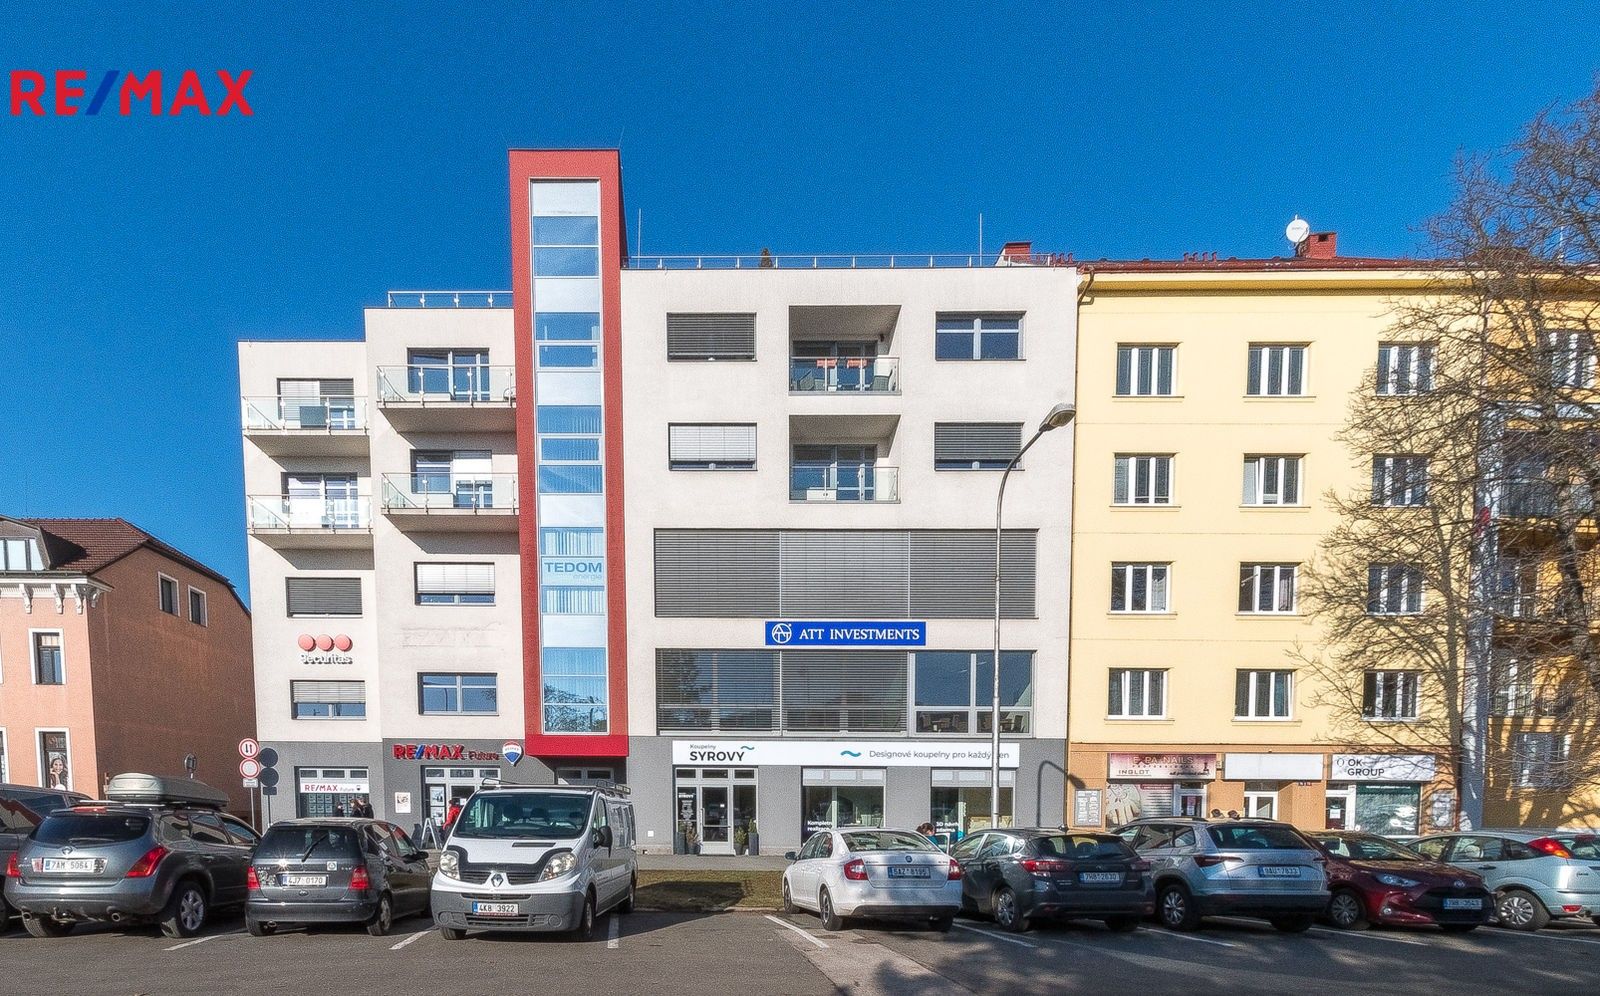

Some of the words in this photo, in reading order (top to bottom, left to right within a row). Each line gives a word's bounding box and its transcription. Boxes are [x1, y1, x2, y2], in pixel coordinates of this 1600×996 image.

[544, 562, 602, 573] TEDOM
[799, 629, 824, 640] ATT
[830, 629, 920, 640] INVESTMENTS
[393, 743, 466, 760] RE/MAX
[869, 750, 912, 759] Designové
[914, 751, 950, 760] koupelny
[969, 750, 992, 760] každý
[1348, 758, 1363, 767] OK
[1347, 768, 1385, 776] GROUP
[304, 784, 338, 792] RE/MAX
[288, 877, 301, 885] 4J7
[305, 877, 323, 885] 0170
[496, 904, 515, 913] 3922
